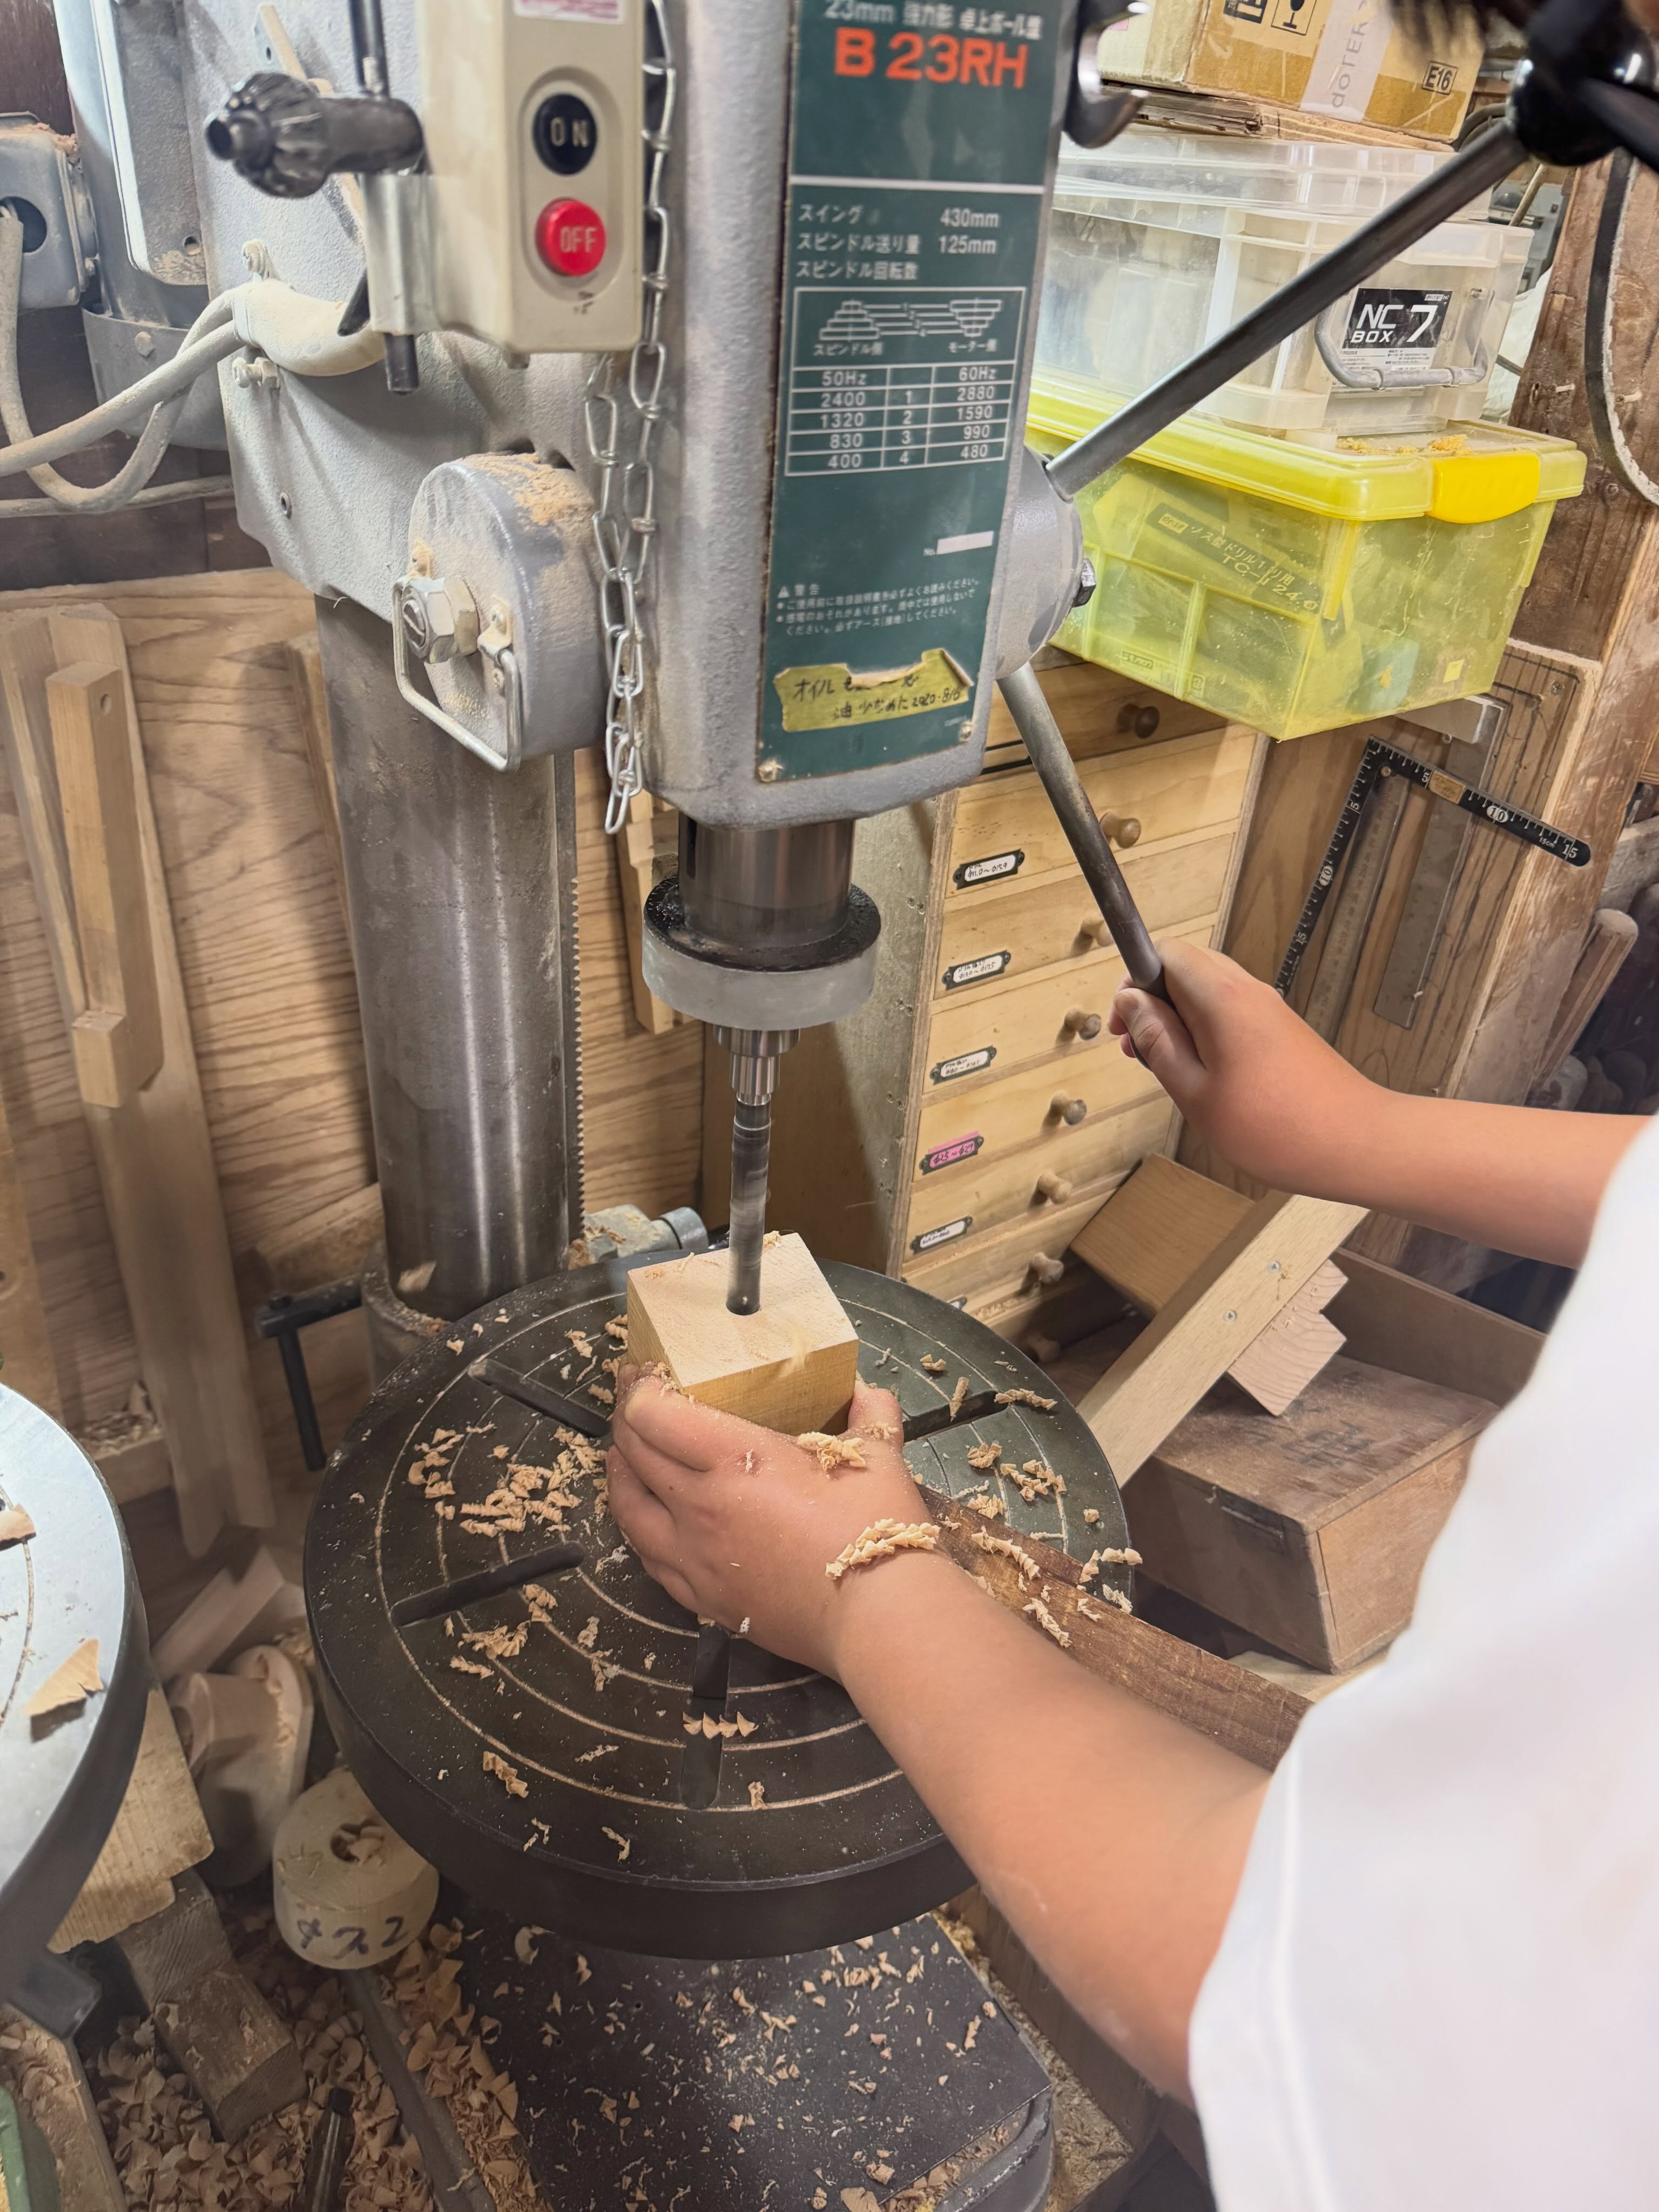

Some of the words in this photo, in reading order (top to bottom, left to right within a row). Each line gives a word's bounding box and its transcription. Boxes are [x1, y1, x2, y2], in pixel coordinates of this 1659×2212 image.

[1425, 65, 1453, 91] E16
[550, 117, 588, 147] ON
[798, 204, 863, 224] スイング
[941, 207, 999, 228] 430mm
[559, 226, 597, 253] OFF
[939, 235, 997, 255] 125mm
[1356, 304, 1404, 329] NC
[1406, 305, 1438, 342] 7
[1351, 331, 1393, 343] BOX
[821, 370, 867, 387] 50Hz
[959, 366, 996, 381] 60Hz
[821, 392, 865, 408] 2400
[905, 390, 912, 404] 1
[957, 386, 995, 401] 2880
[820, 412, 864, 428] 1320
[903, 410, 912, 424] 2
[957, 406, 993, 420] 1590
[830, 433, 862, 448] 830
[902, 431, 911, 445] 3
[963, 424, 990, 440] 990
[827, 454, 862, 469] 400
[899, 451, 909, 465] 4
[960, 444, 988, 458] 480
[1488, 806, 1507, 822] 10
[1561, 843, 1579, 859] 15
